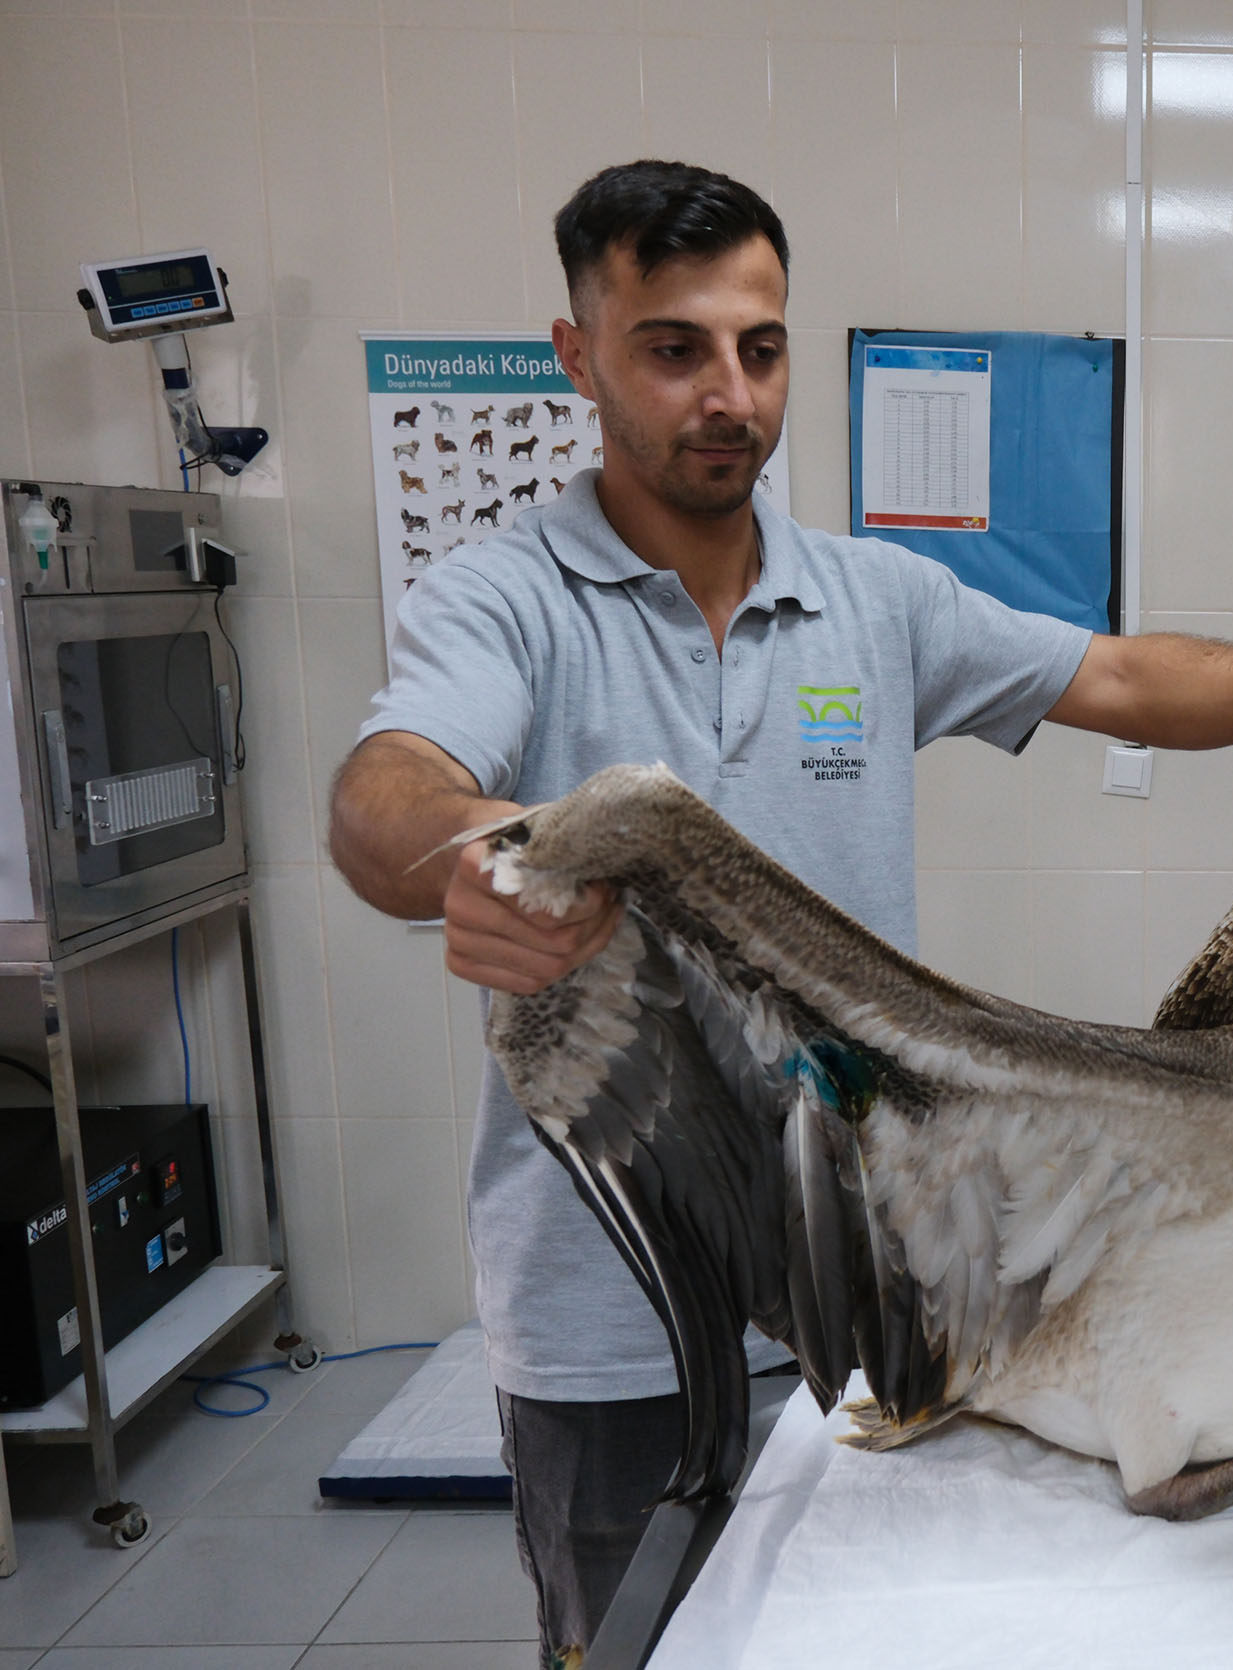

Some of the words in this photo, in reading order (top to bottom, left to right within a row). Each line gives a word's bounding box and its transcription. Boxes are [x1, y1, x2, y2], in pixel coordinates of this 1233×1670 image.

[384, 353, 495, 380] Dünyadaki
[387, 379, 406, 390] Dogs
[408, 379, 416, 389] of
[417, 379, 429, 389] the
[431, 379, 451, 389] world
[831, 747, 846, 756] T.C.
[815, 768, 860, 781] BELEDİYESİ
[40, 1207, 67, 1234] delta
